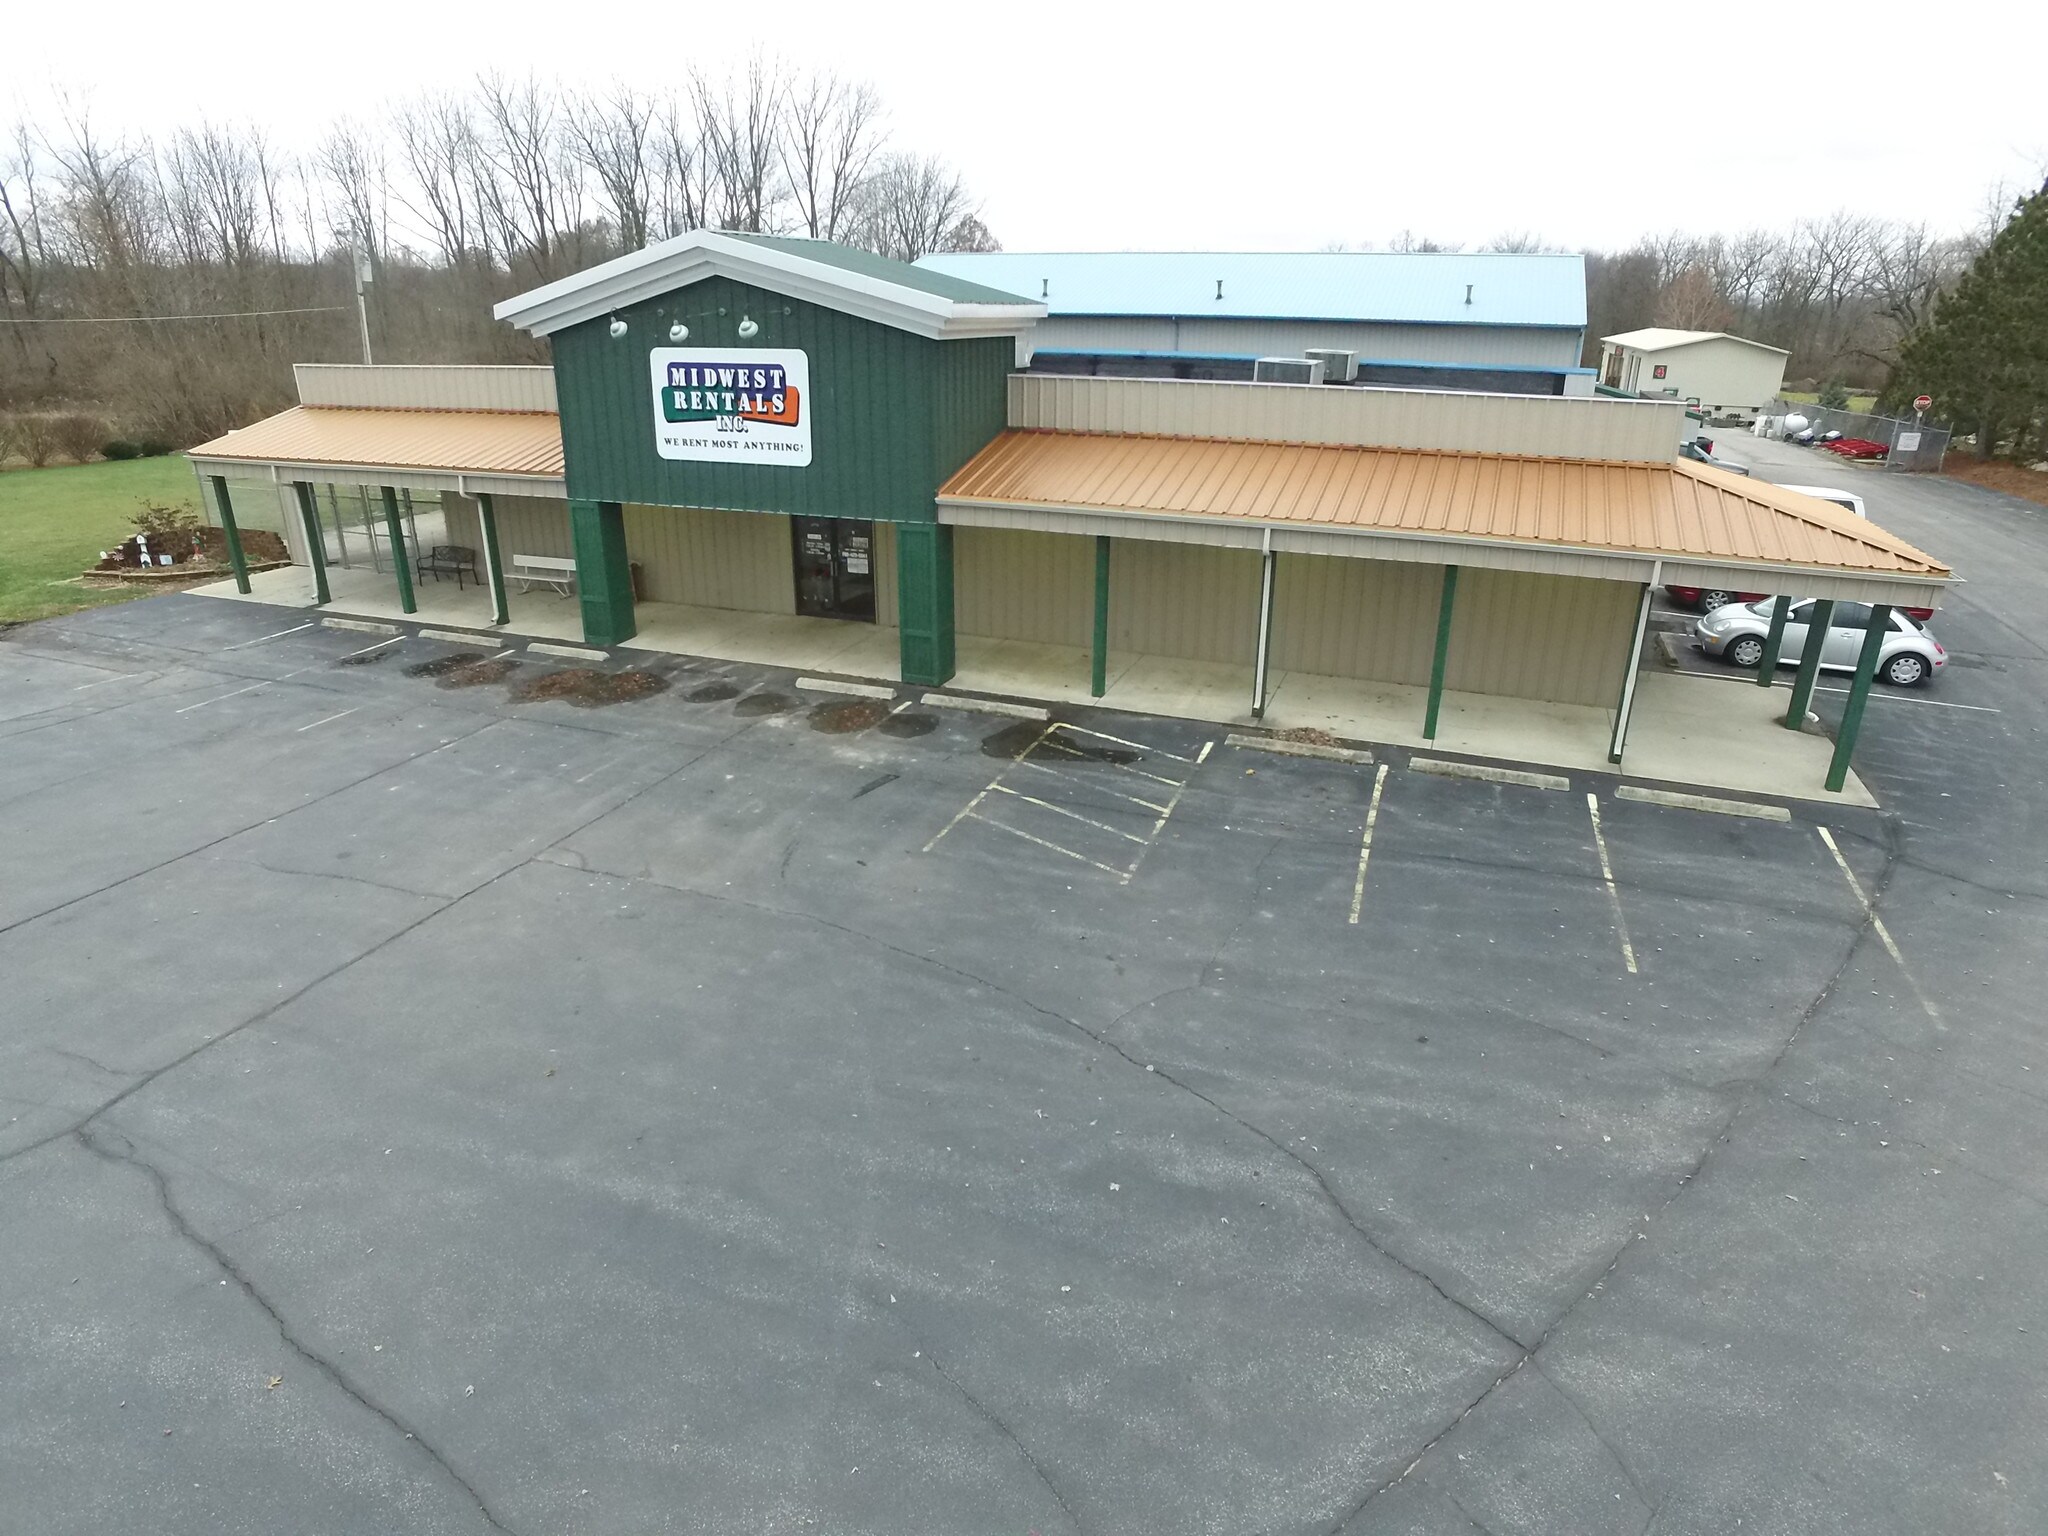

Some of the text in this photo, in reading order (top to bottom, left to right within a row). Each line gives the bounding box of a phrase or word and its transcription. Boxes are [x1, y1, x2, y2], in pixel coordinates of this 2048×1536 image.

[670, 367, 783, 388] MIDWEST
[1655, 366, 1665, 378] 4
[674, 391, 785, 413] RENTALS
[715, 415, 749, 433] INC.
[664, 437, 804, 452] WE RENT MOST ANYTHING!
